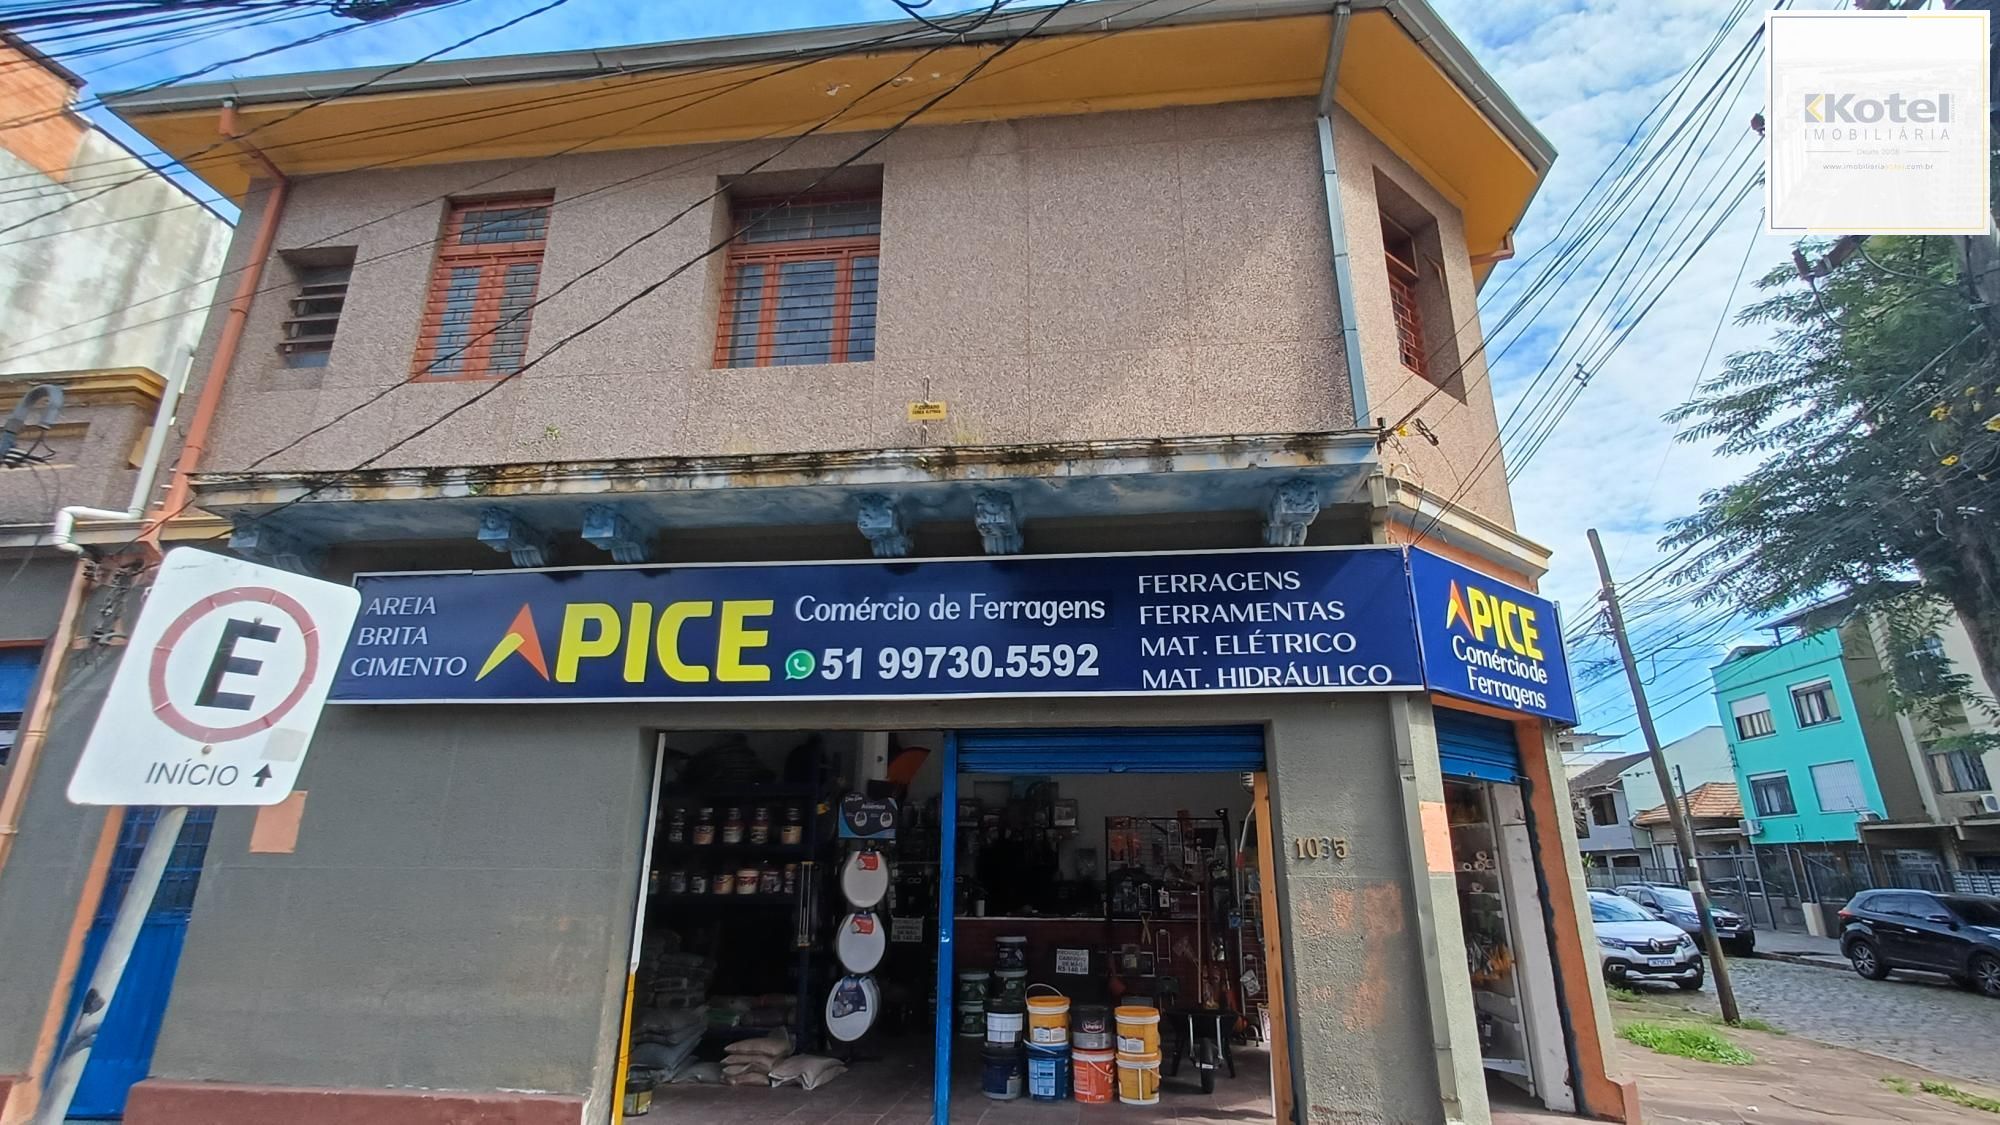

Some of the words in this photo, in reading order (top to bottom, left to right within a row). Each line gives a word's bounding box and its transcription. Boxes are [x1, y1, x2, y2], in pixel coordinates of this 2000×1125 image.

[1138, 570, 1302, 595] FERRAGENS
[365, 596, 437, 617] AREIA
[795, 594, 920, 622] Comércio
[928, 593, 961, 621] de
[969, 593, 1106, 627] Ferragens
[1140, 600, 1346, 625] FERRAMENTAS
[357, 626, 429, 646] BRITA
[1141, 636, 1208, 657] MAT.
[1215, 629, 1357, 656] ELÉTRICO
[195, 618, 283, 711] E
[350, 656, 467, 678] CIMENTO
[821, 647, 863, 681] 51
[878, 643, 1100, 680] 99730.5592
[1142, 668, 1211, 690] MAT.
[1218, 661, 1393, 688] HIDRÁULICO
[1467, 666, 1547, 709] Ferragens
[145, 757, 239, 787] INÍCIO
[1296, 836, 1348, 860] 1035
